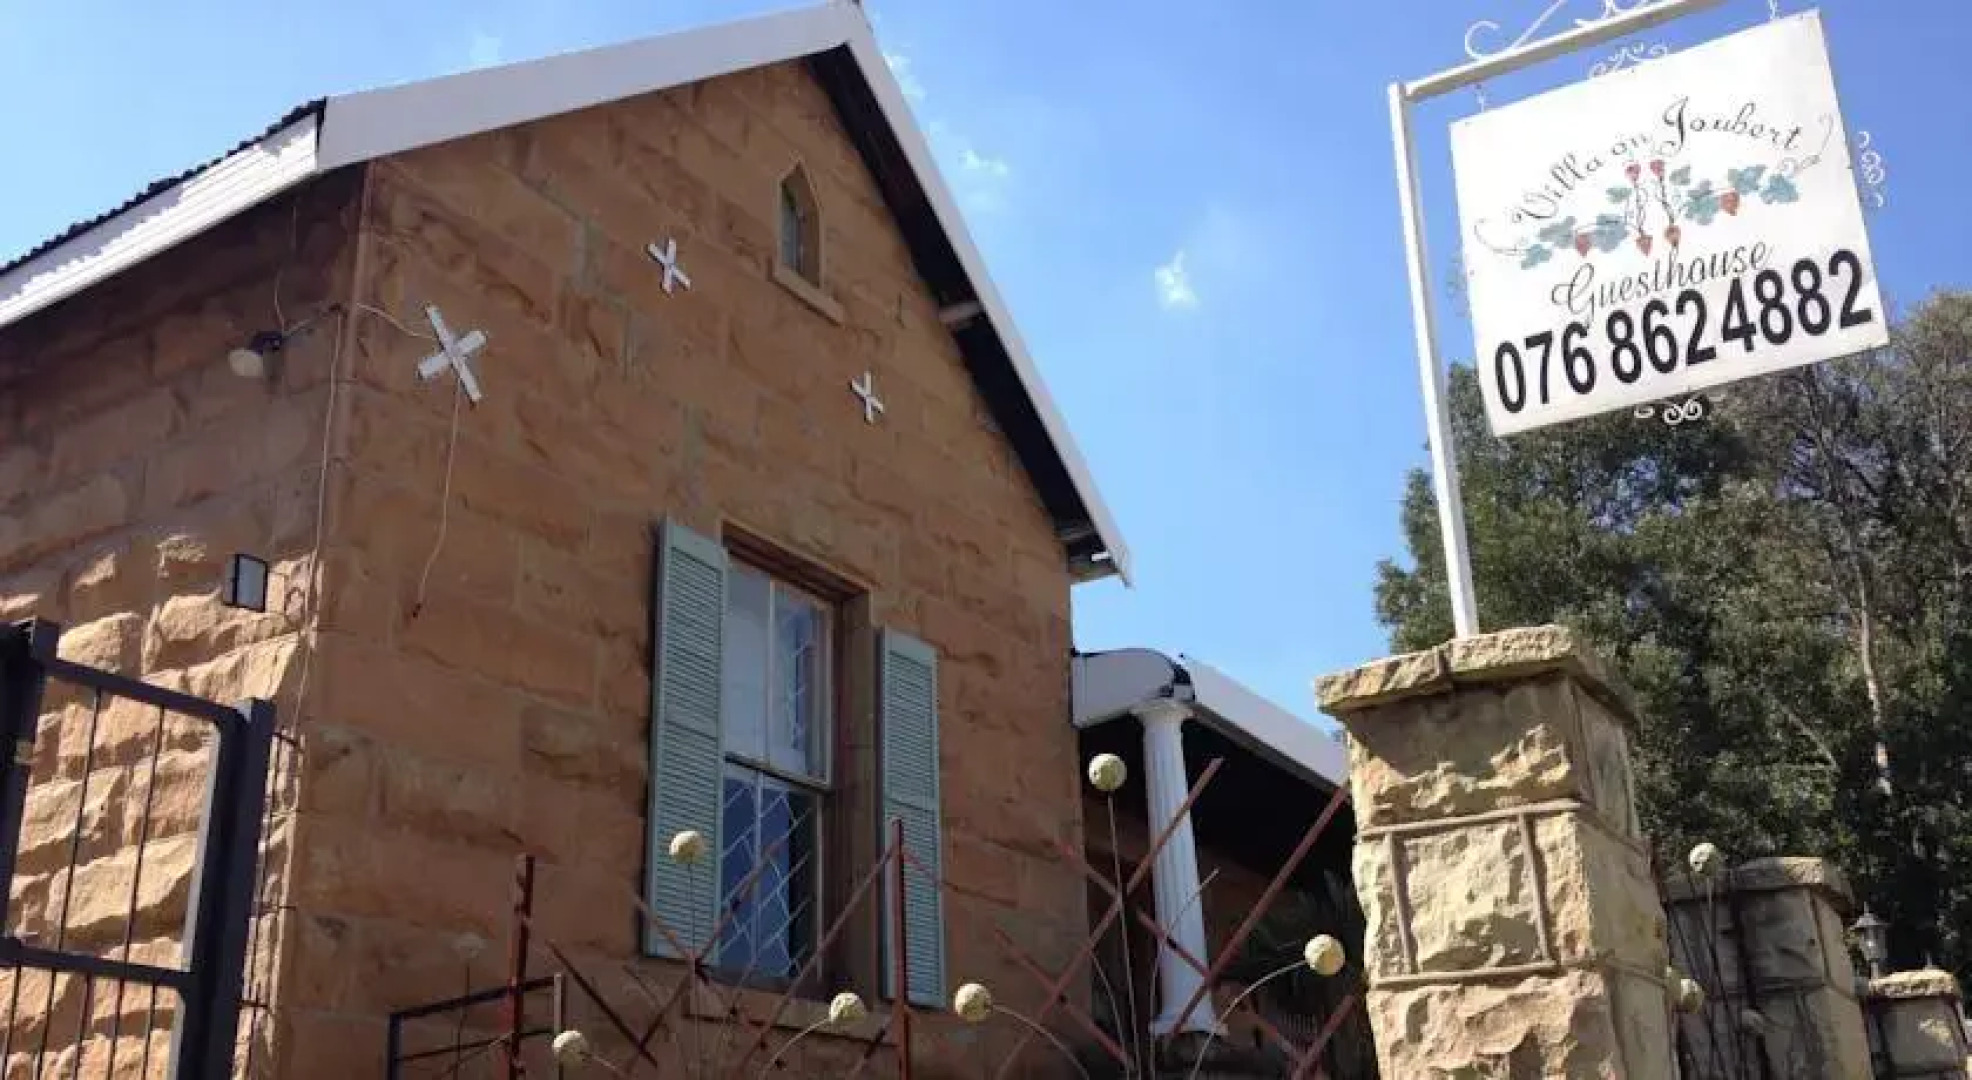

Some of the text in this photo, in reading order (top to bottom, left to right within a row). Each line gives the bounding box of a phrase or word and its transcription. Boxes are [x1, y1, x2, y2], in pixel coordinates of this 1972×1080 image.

[1612, 133, 1650, 156] on
[1657, 95, 1802, 158] Joubert
[1552, 241, 1774, 331] Guesthouse
[1494, 320, 1597, 414] 076
